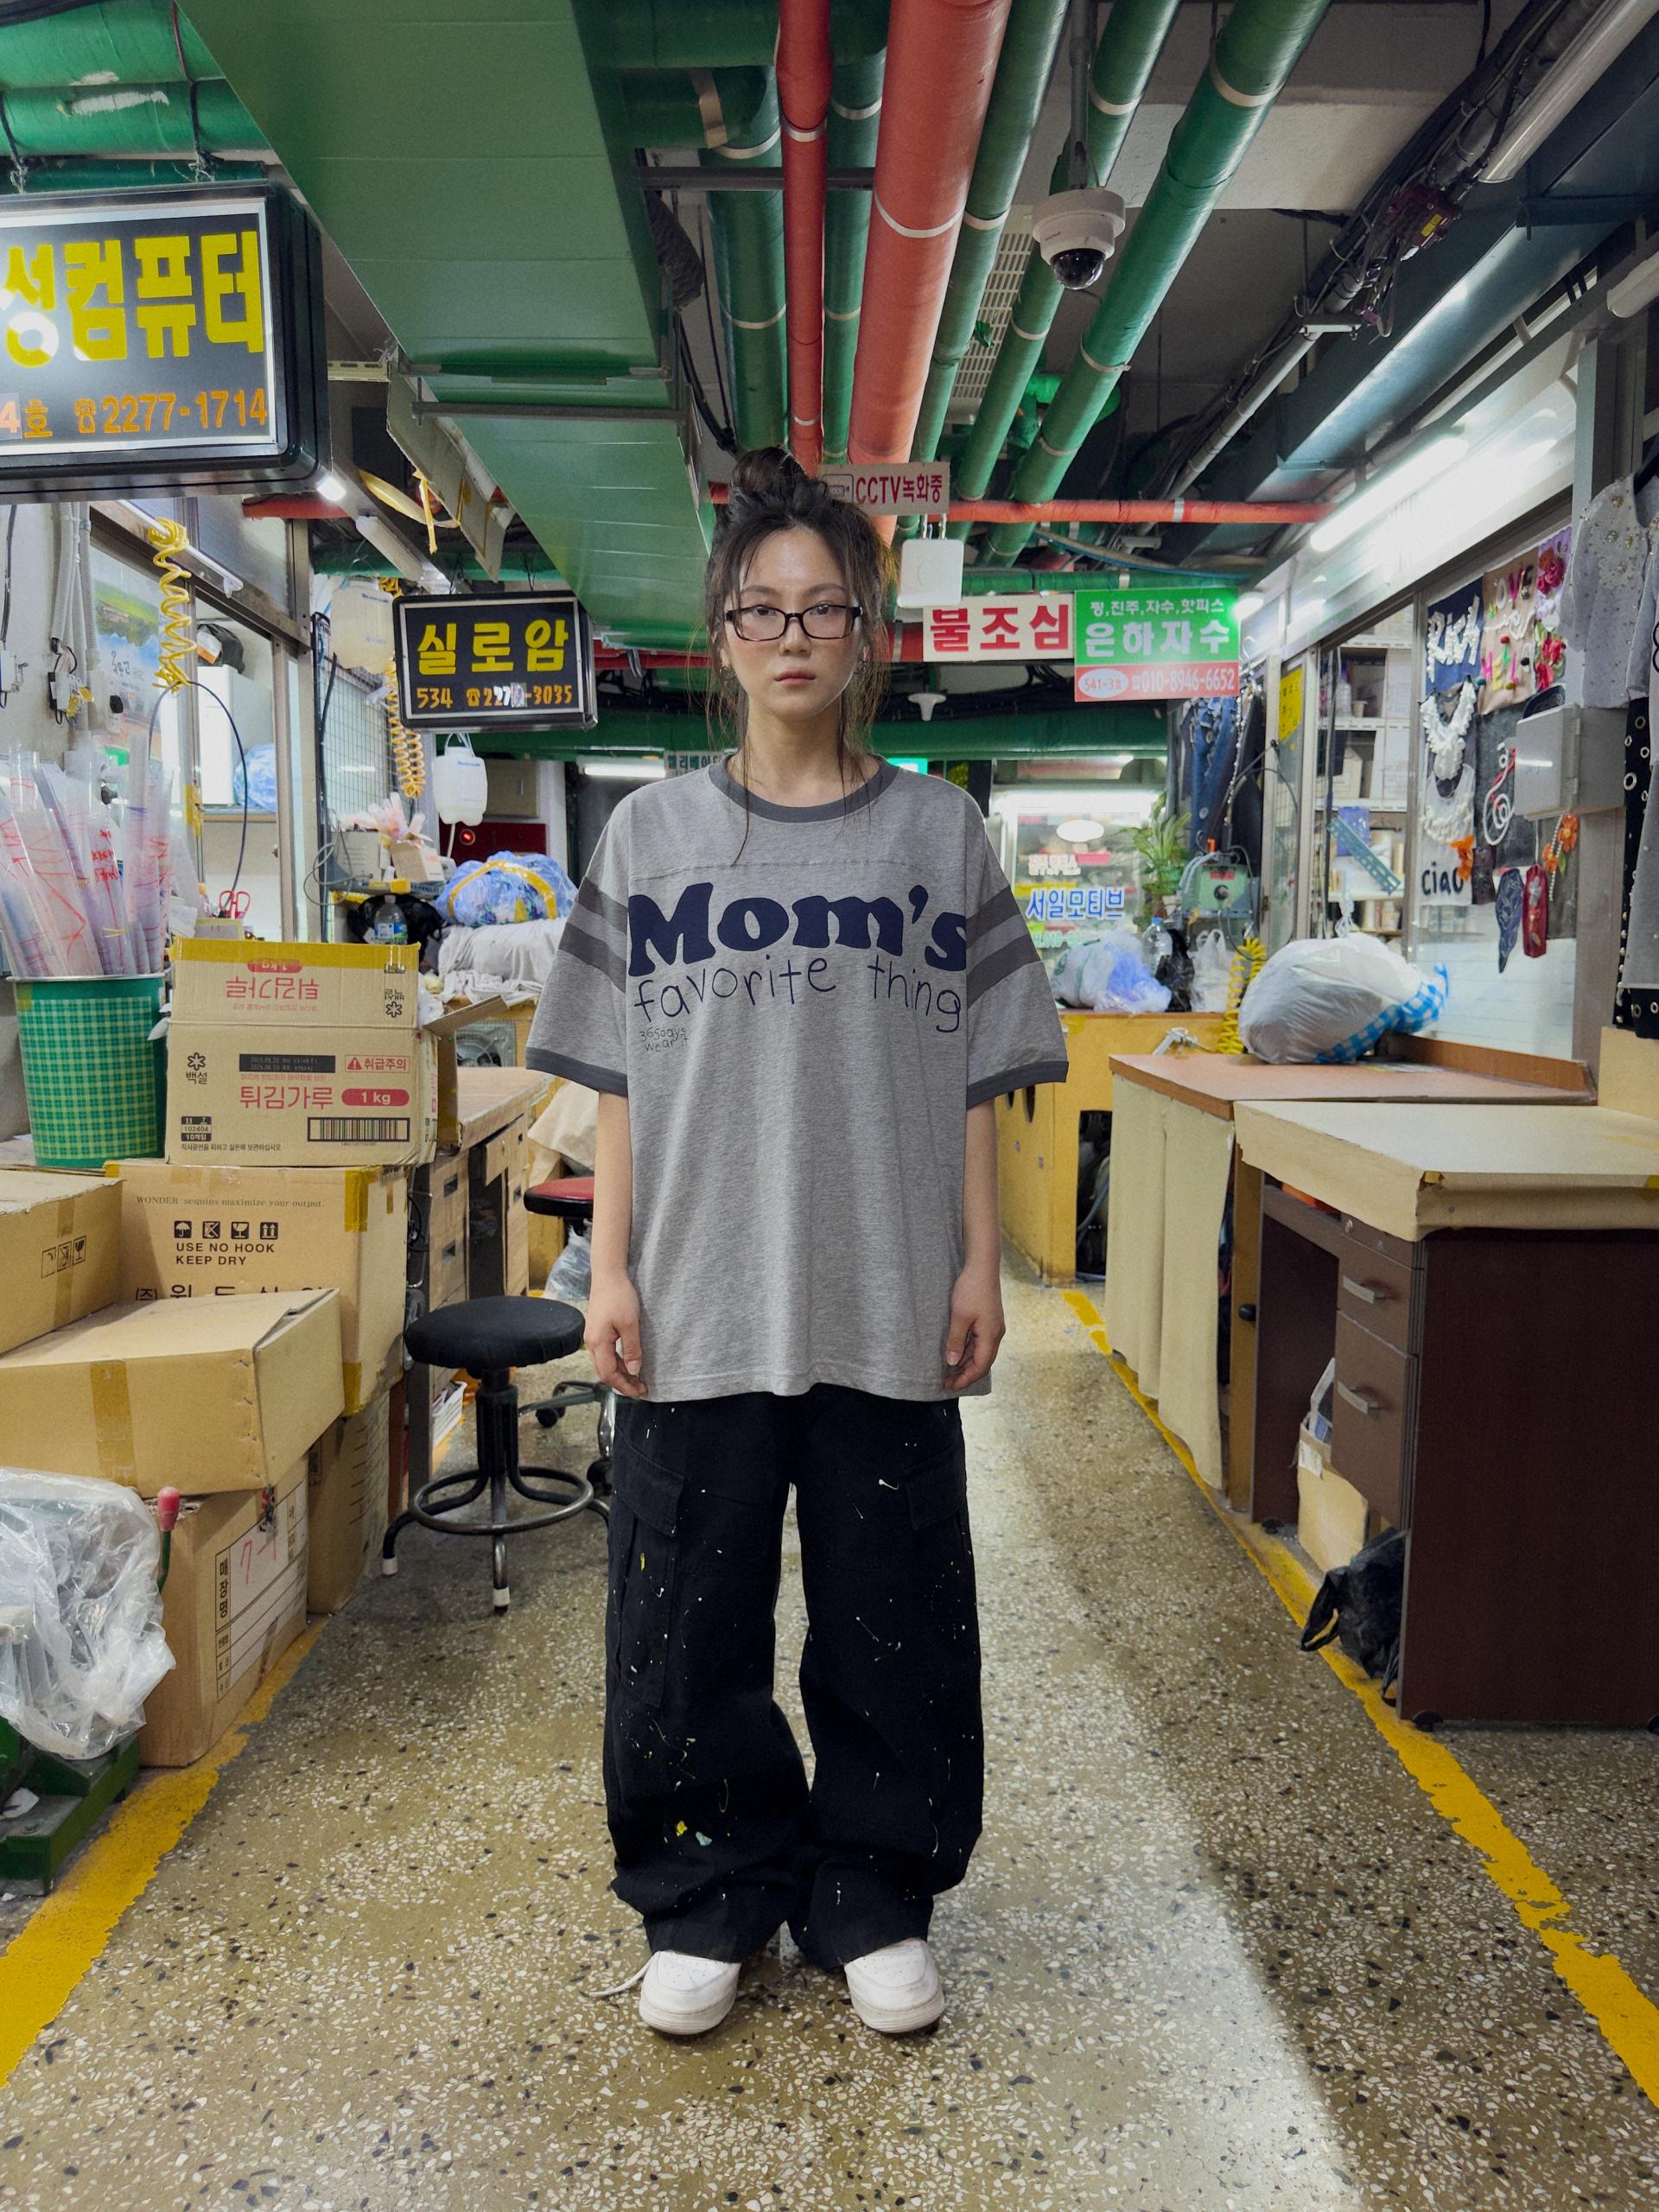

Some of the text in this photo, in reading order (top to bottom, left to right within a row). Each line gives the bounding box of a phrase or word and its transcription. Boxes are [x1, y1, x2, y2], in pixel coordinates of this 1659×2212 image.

[0, 230, 264, 367] 성컴퓨터
[102, 388, 268, 434] 2277-1714
[855, 474, 943, 505] CCTV녹화중
[930, 605, 1069, 652] 불조심
[1084, 620, 1230, 658] 은하자수
[417, 619, 569, 676] 실로암
[1142, 667, 1236, 692] 010-8946-6652
[416, 687, 453, 709] 534
[628, 882, 966, 976] Mom's
[226, 976, 320, 1000] 튀김가루
[634, 954, 962, 1033] favorite thing
[364, 1056, 408, 1071] 취급주의
[185, 1071, 208, 1084] 백설
[239, 1085, 334, 1110] 튀김가루
[268, 1199, 290, 1209] your
[175, 1255, 247, 1266] KEEP DRY
[176, 1243, 275, 1253] USE NO HOOK
